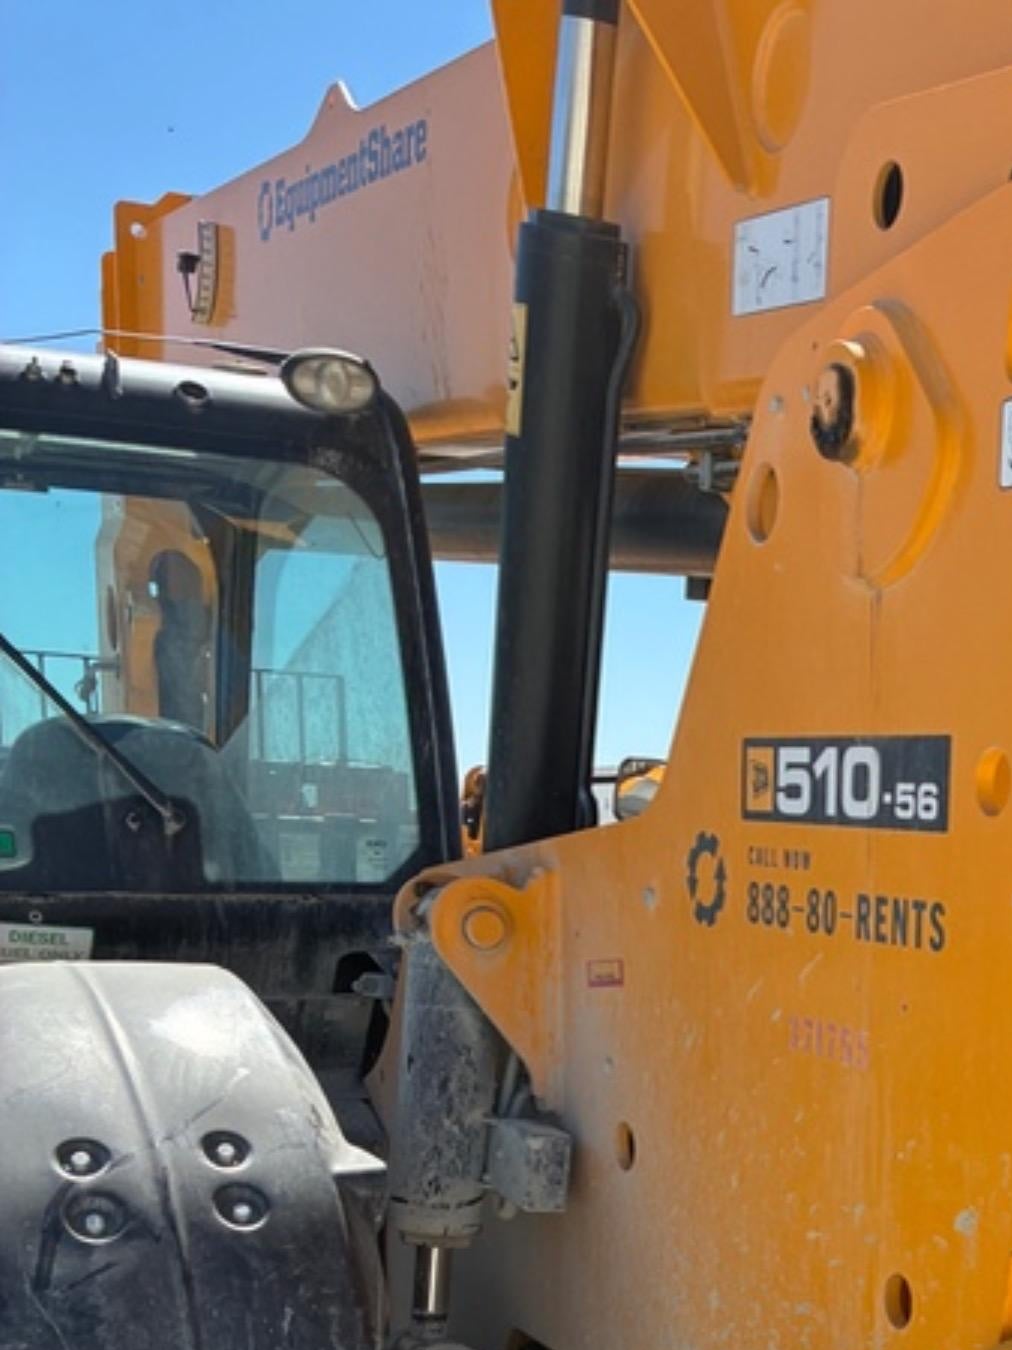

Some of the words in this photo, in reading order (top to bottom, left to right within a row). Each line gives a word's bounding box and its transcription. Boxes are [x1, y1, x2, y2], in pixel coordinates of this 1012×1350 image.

[275, 118, 428, 232] EquipmentShare
[748, 845, 778, 868] CALL
[8, 930, 69, 945] DIESEL
[747, 880, 947, 952] 888-80-RENTS
